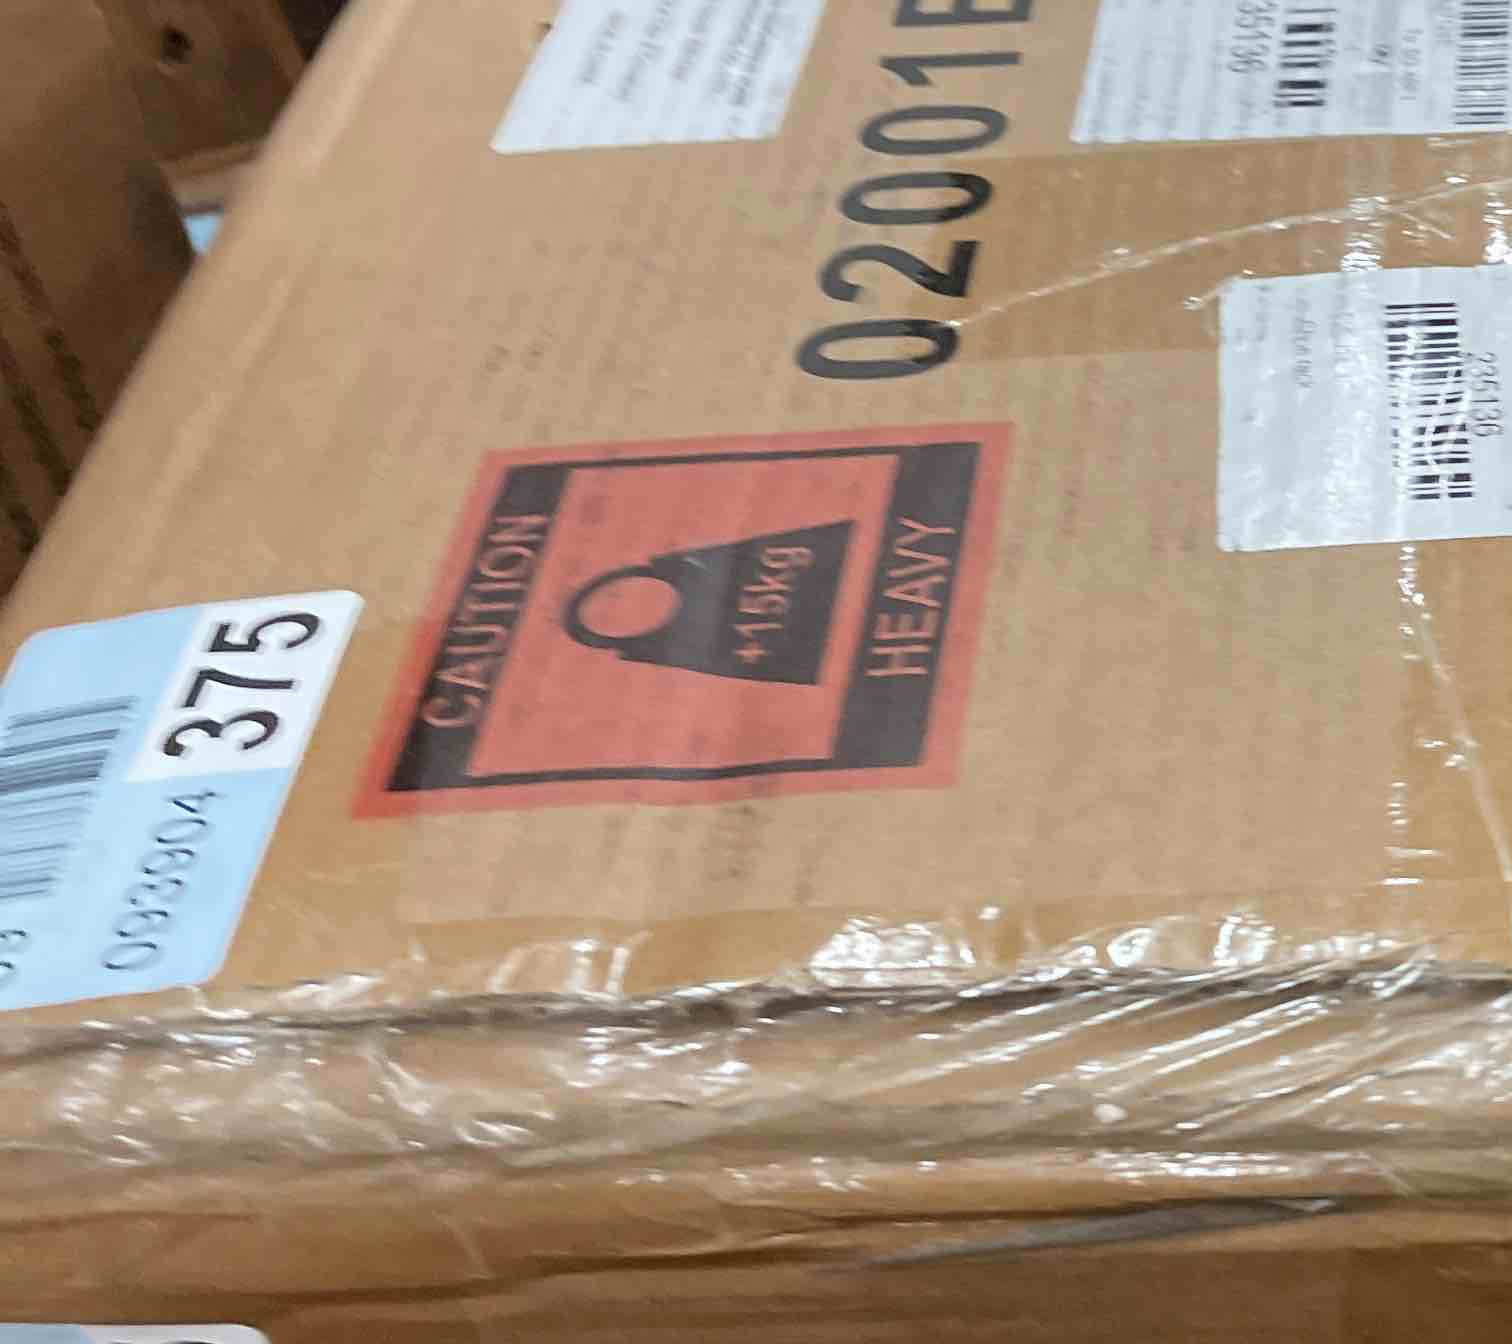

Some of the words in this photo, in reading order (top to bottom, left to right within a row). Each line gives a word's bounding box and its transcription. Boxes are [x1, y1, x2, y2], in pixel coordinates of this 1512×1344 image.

[420, 512, 548, 729] CAUTION
[735, 545, 813, 664] +15kg
[865, 516, 956, 680] HEAVY
[162, 609, 322, 758] 375
